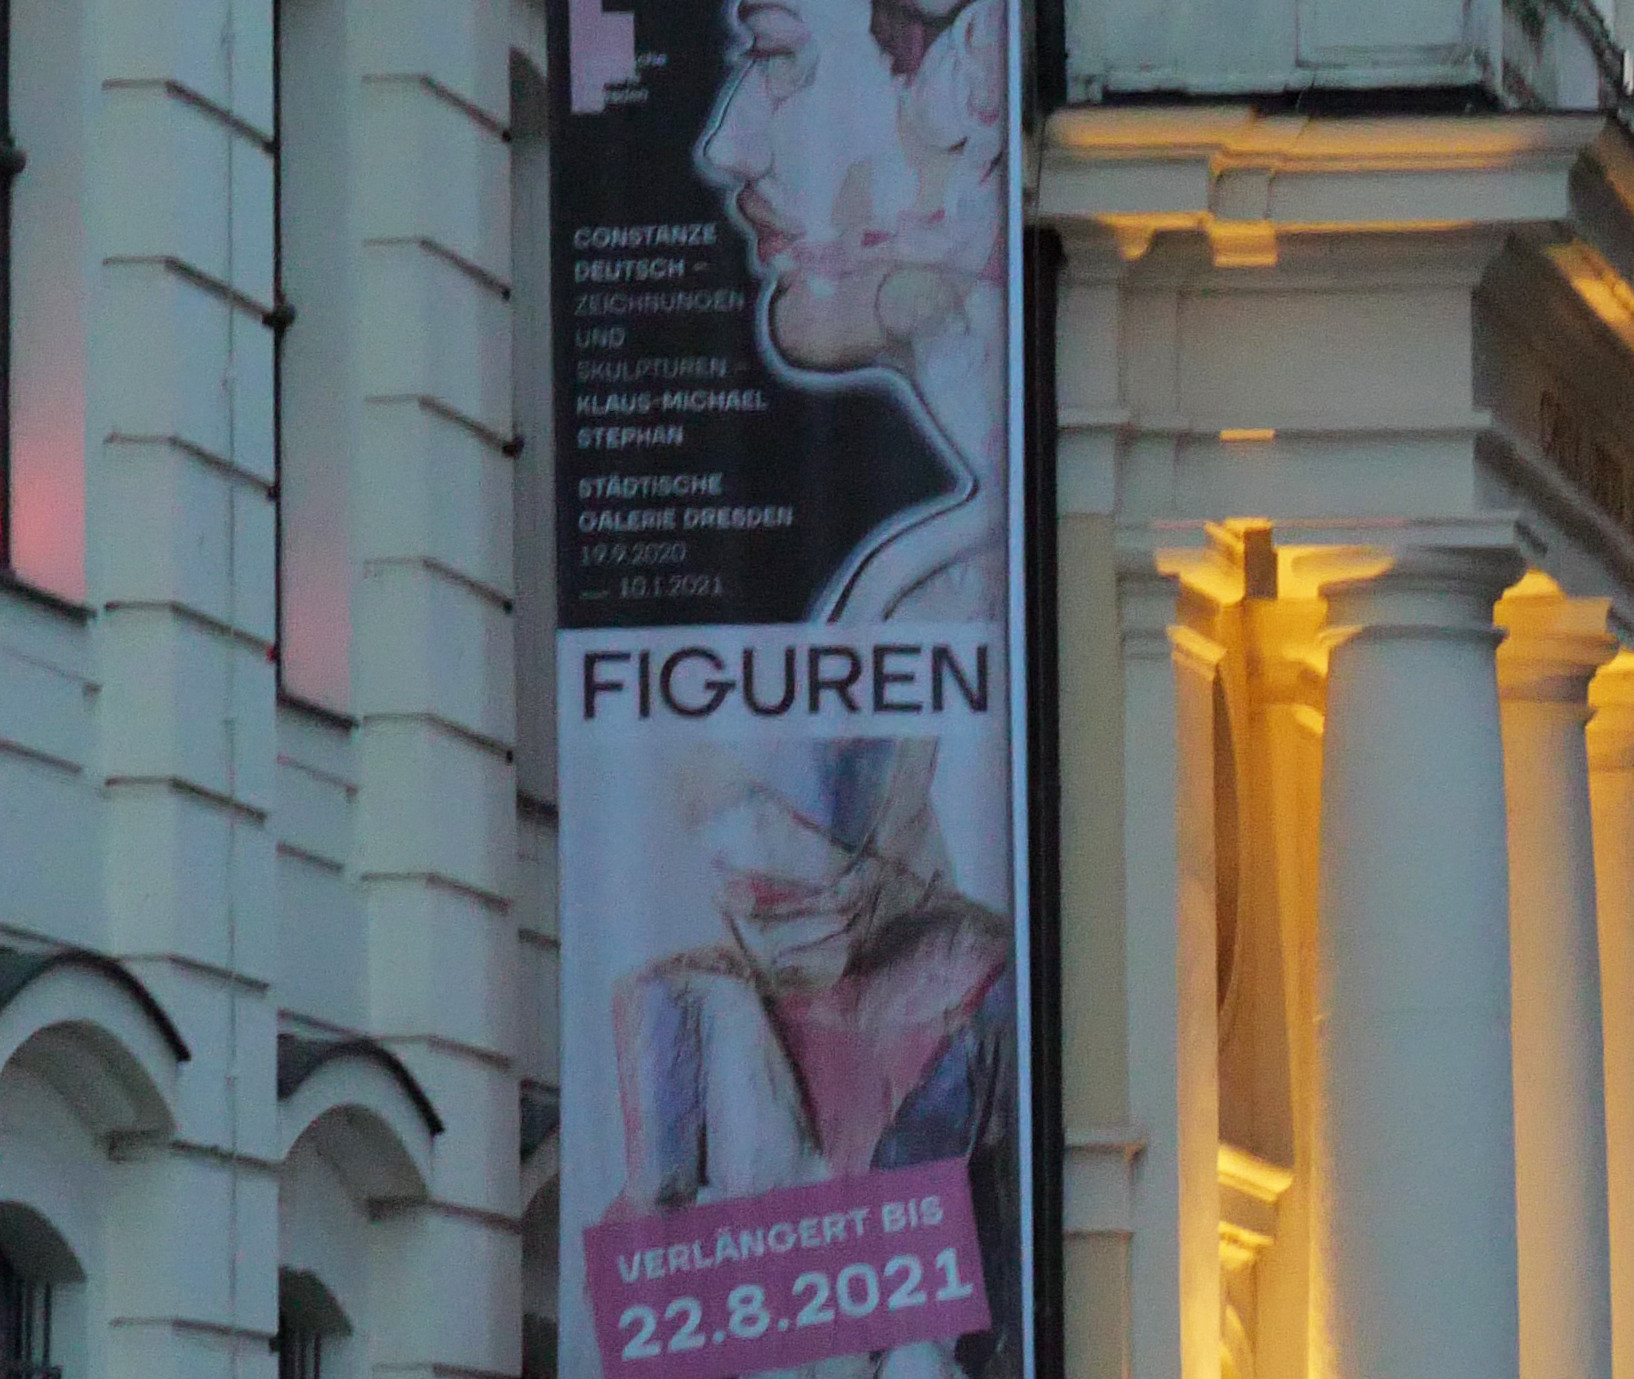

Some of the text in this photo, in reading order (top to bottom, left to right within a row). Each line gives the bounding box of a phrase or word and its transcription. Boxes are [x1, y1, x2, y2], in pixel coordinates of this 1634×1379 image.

[574, 223, 718, 249] CONSTANZE
[574, 257, 686, 284] DEUTSCH
[575, 288, 746, 316] ZEICHNUNGEN
[576, 327, 627, 349] UND
[576, 357, 728, 382] SKULPTUREN
[577, 424, 684, 450] STEPHAN
[578, 471, 724, 500] STÄDTISCHE
[578, 504, 795, 533] GALERIE DRESDEN
[582, 644, 990, 720] FIGUREN
[617, 1195, 944, 1284] VERLÄNGERT BIS
[617, 1246, 975, 1362] 22.8.2021
